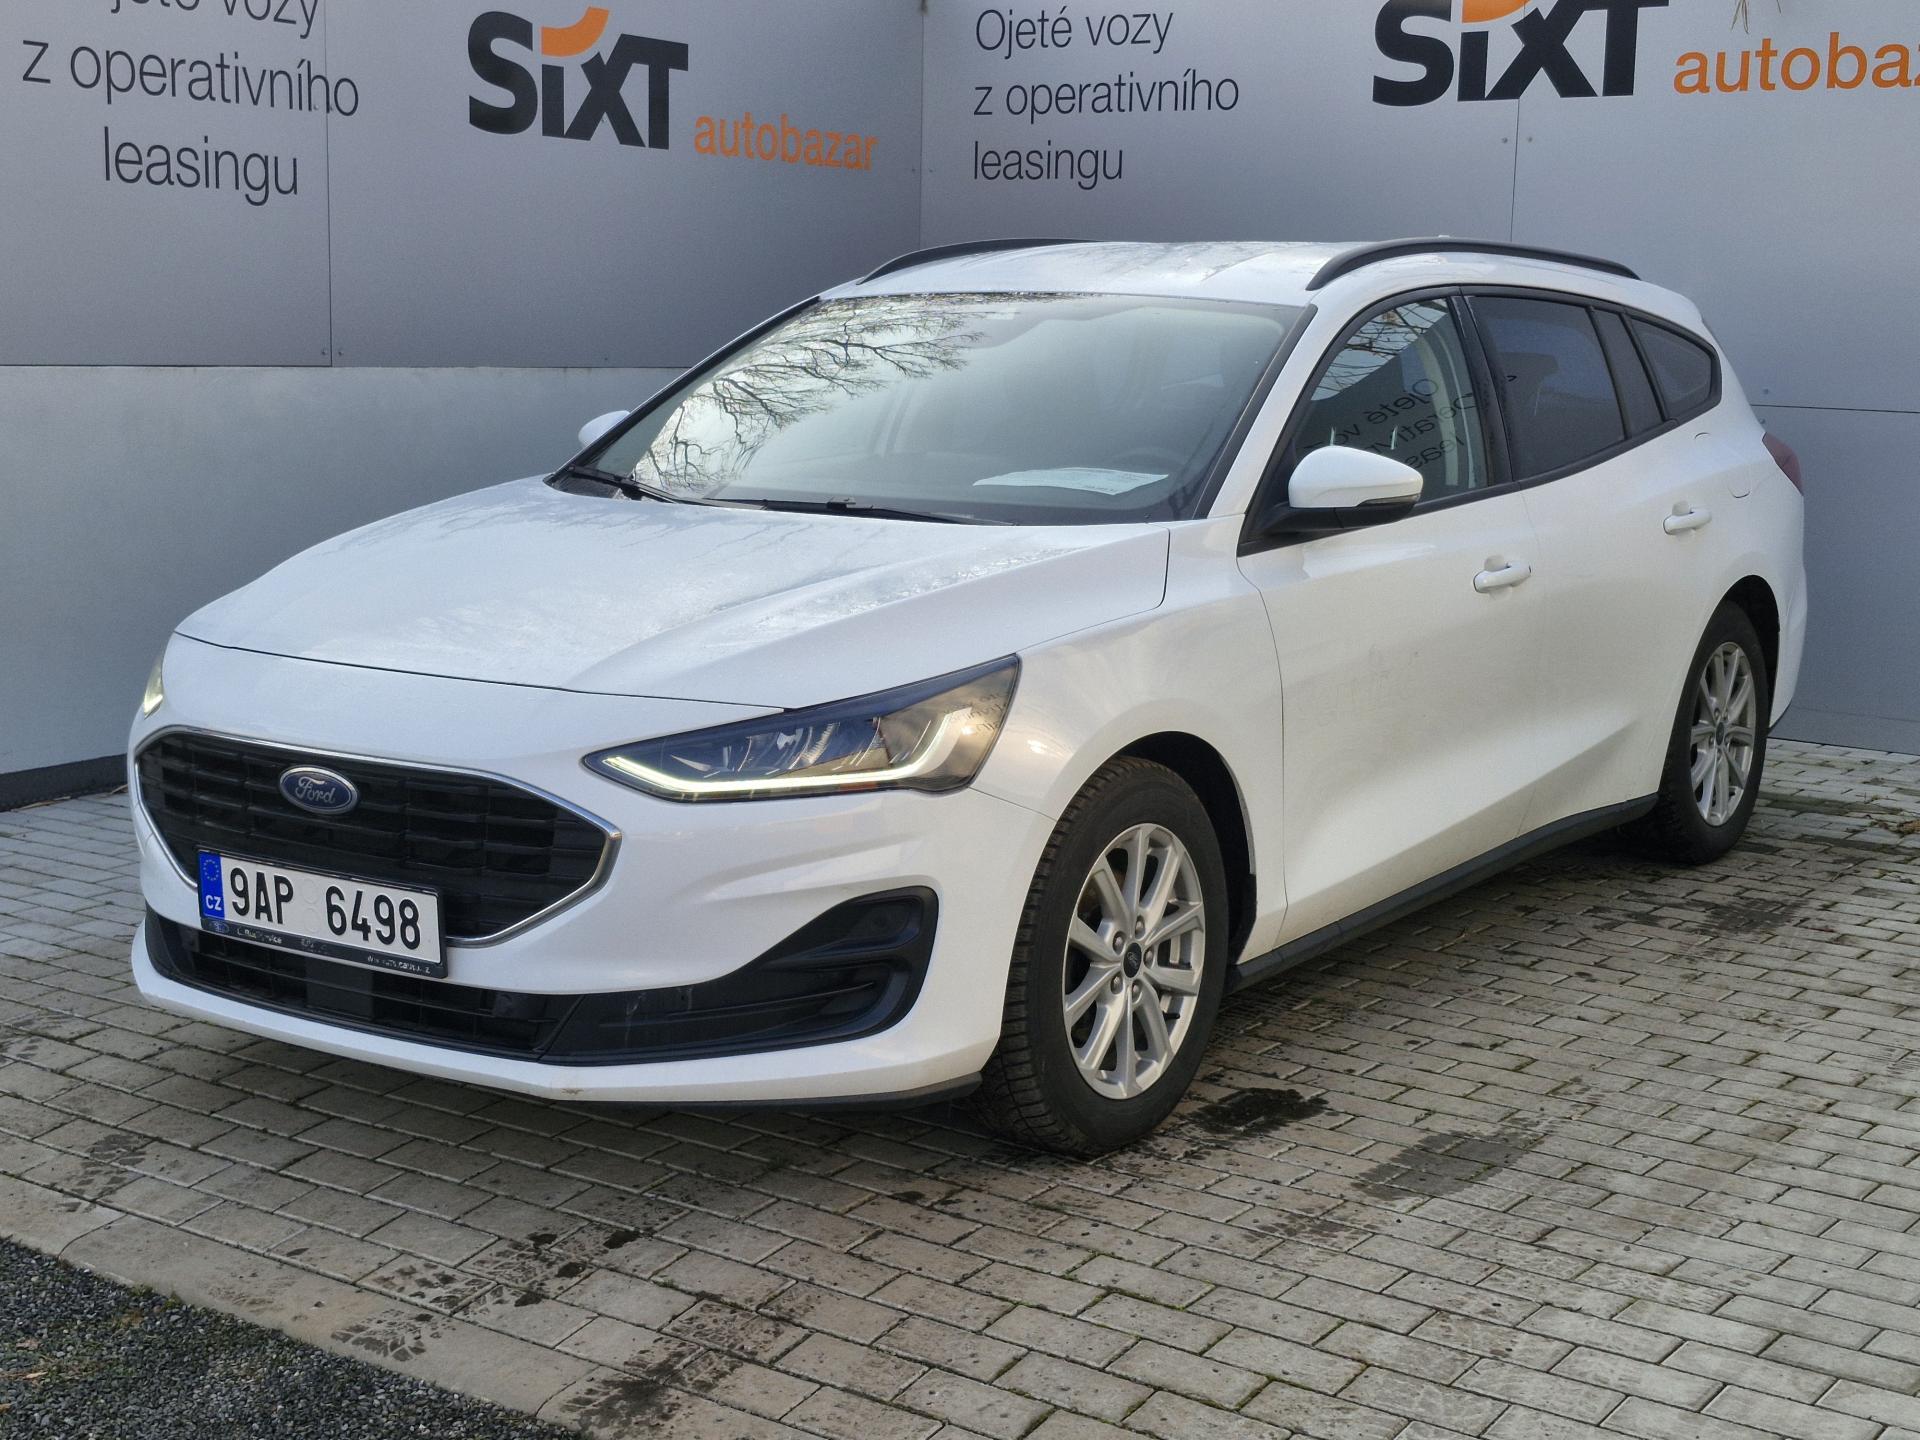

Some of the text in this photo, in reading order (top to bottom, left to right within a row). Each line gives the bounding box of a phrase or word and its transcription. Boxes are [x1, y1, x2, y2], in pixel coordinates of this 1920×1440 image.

[975, 6, 1174, 58] Ojeté vozy
[22, 40, 361, 118] z operativního
[974, 69, 1240, 127] z operativního
[104, 126, 299, 208] leasingu
[694, 113, 879, 172] autobazar
[973, 140, 1124, 191] leasingu
[295, 776, 336, 803] Ford
[205, 894, 223, 911] CZ
[229, 867, 420, 949] 9AP 6498
